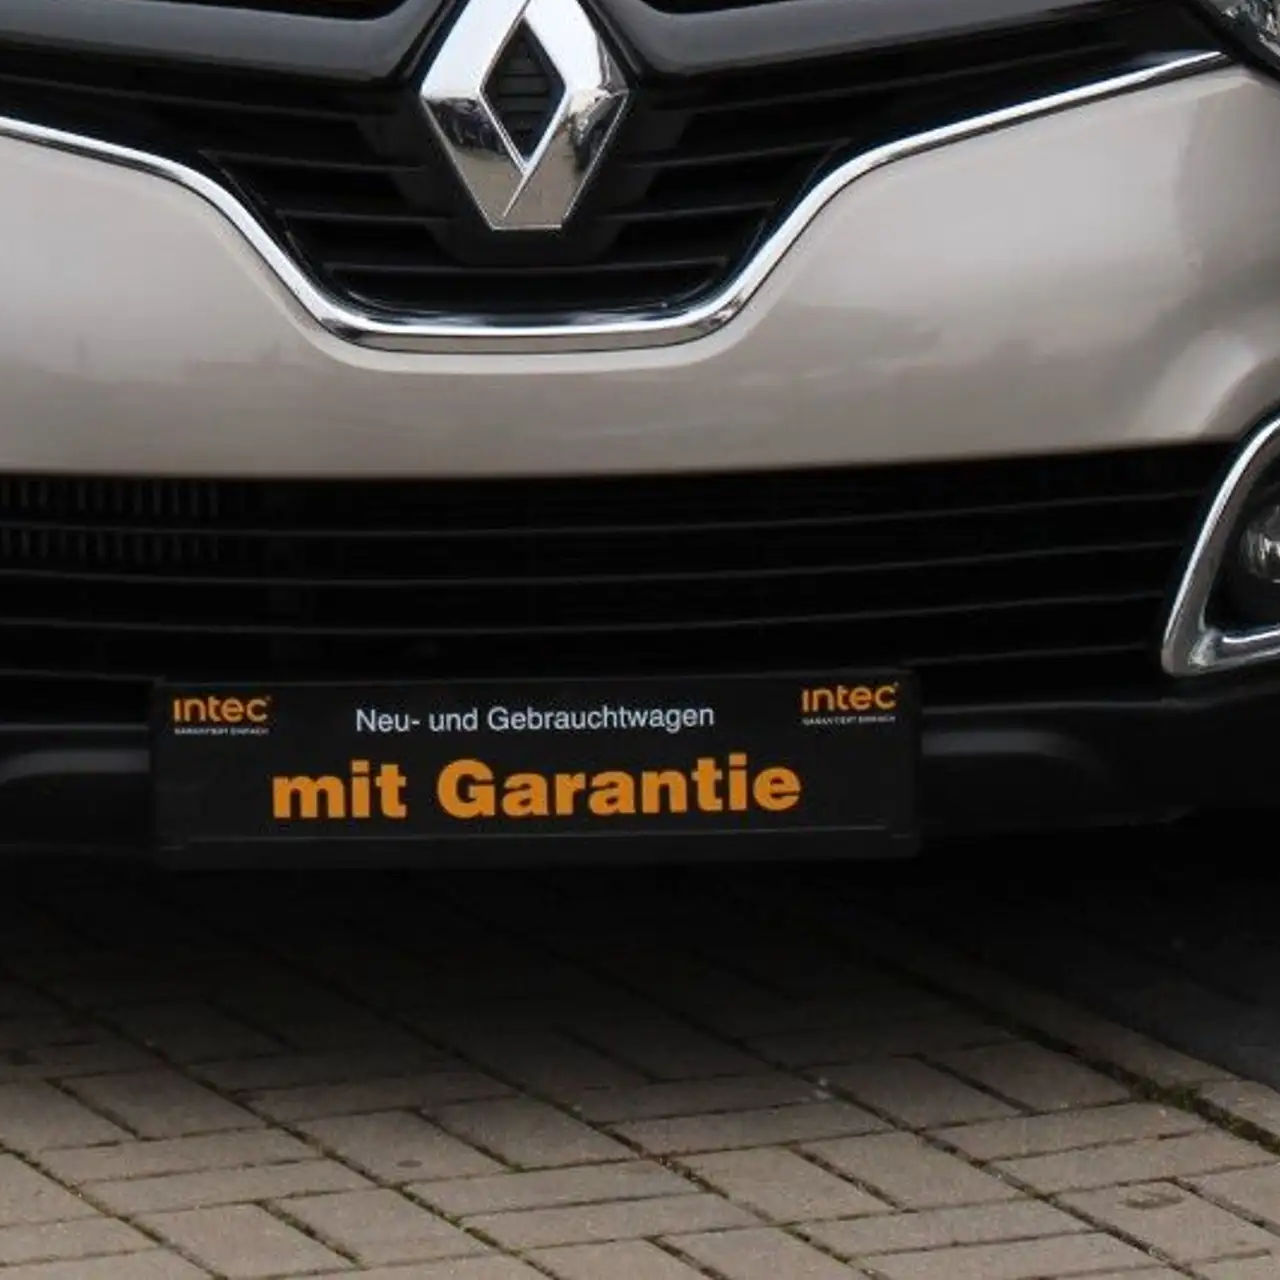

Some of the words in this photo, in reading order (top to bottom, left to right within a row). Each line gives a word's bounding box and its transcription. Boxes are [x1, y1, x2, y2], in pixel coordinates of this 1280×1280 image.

[174, 696, 270, 722] intec
[802, 684, 898, 711] intec
[355, 709, 420, 732] Neu-
[429, 708, 478, 732] und
[487, 705, 715, 733] Gebrauchtwagen
[272, 760, 407, 818] mit
[436, 754, 801, 818] Garantie
